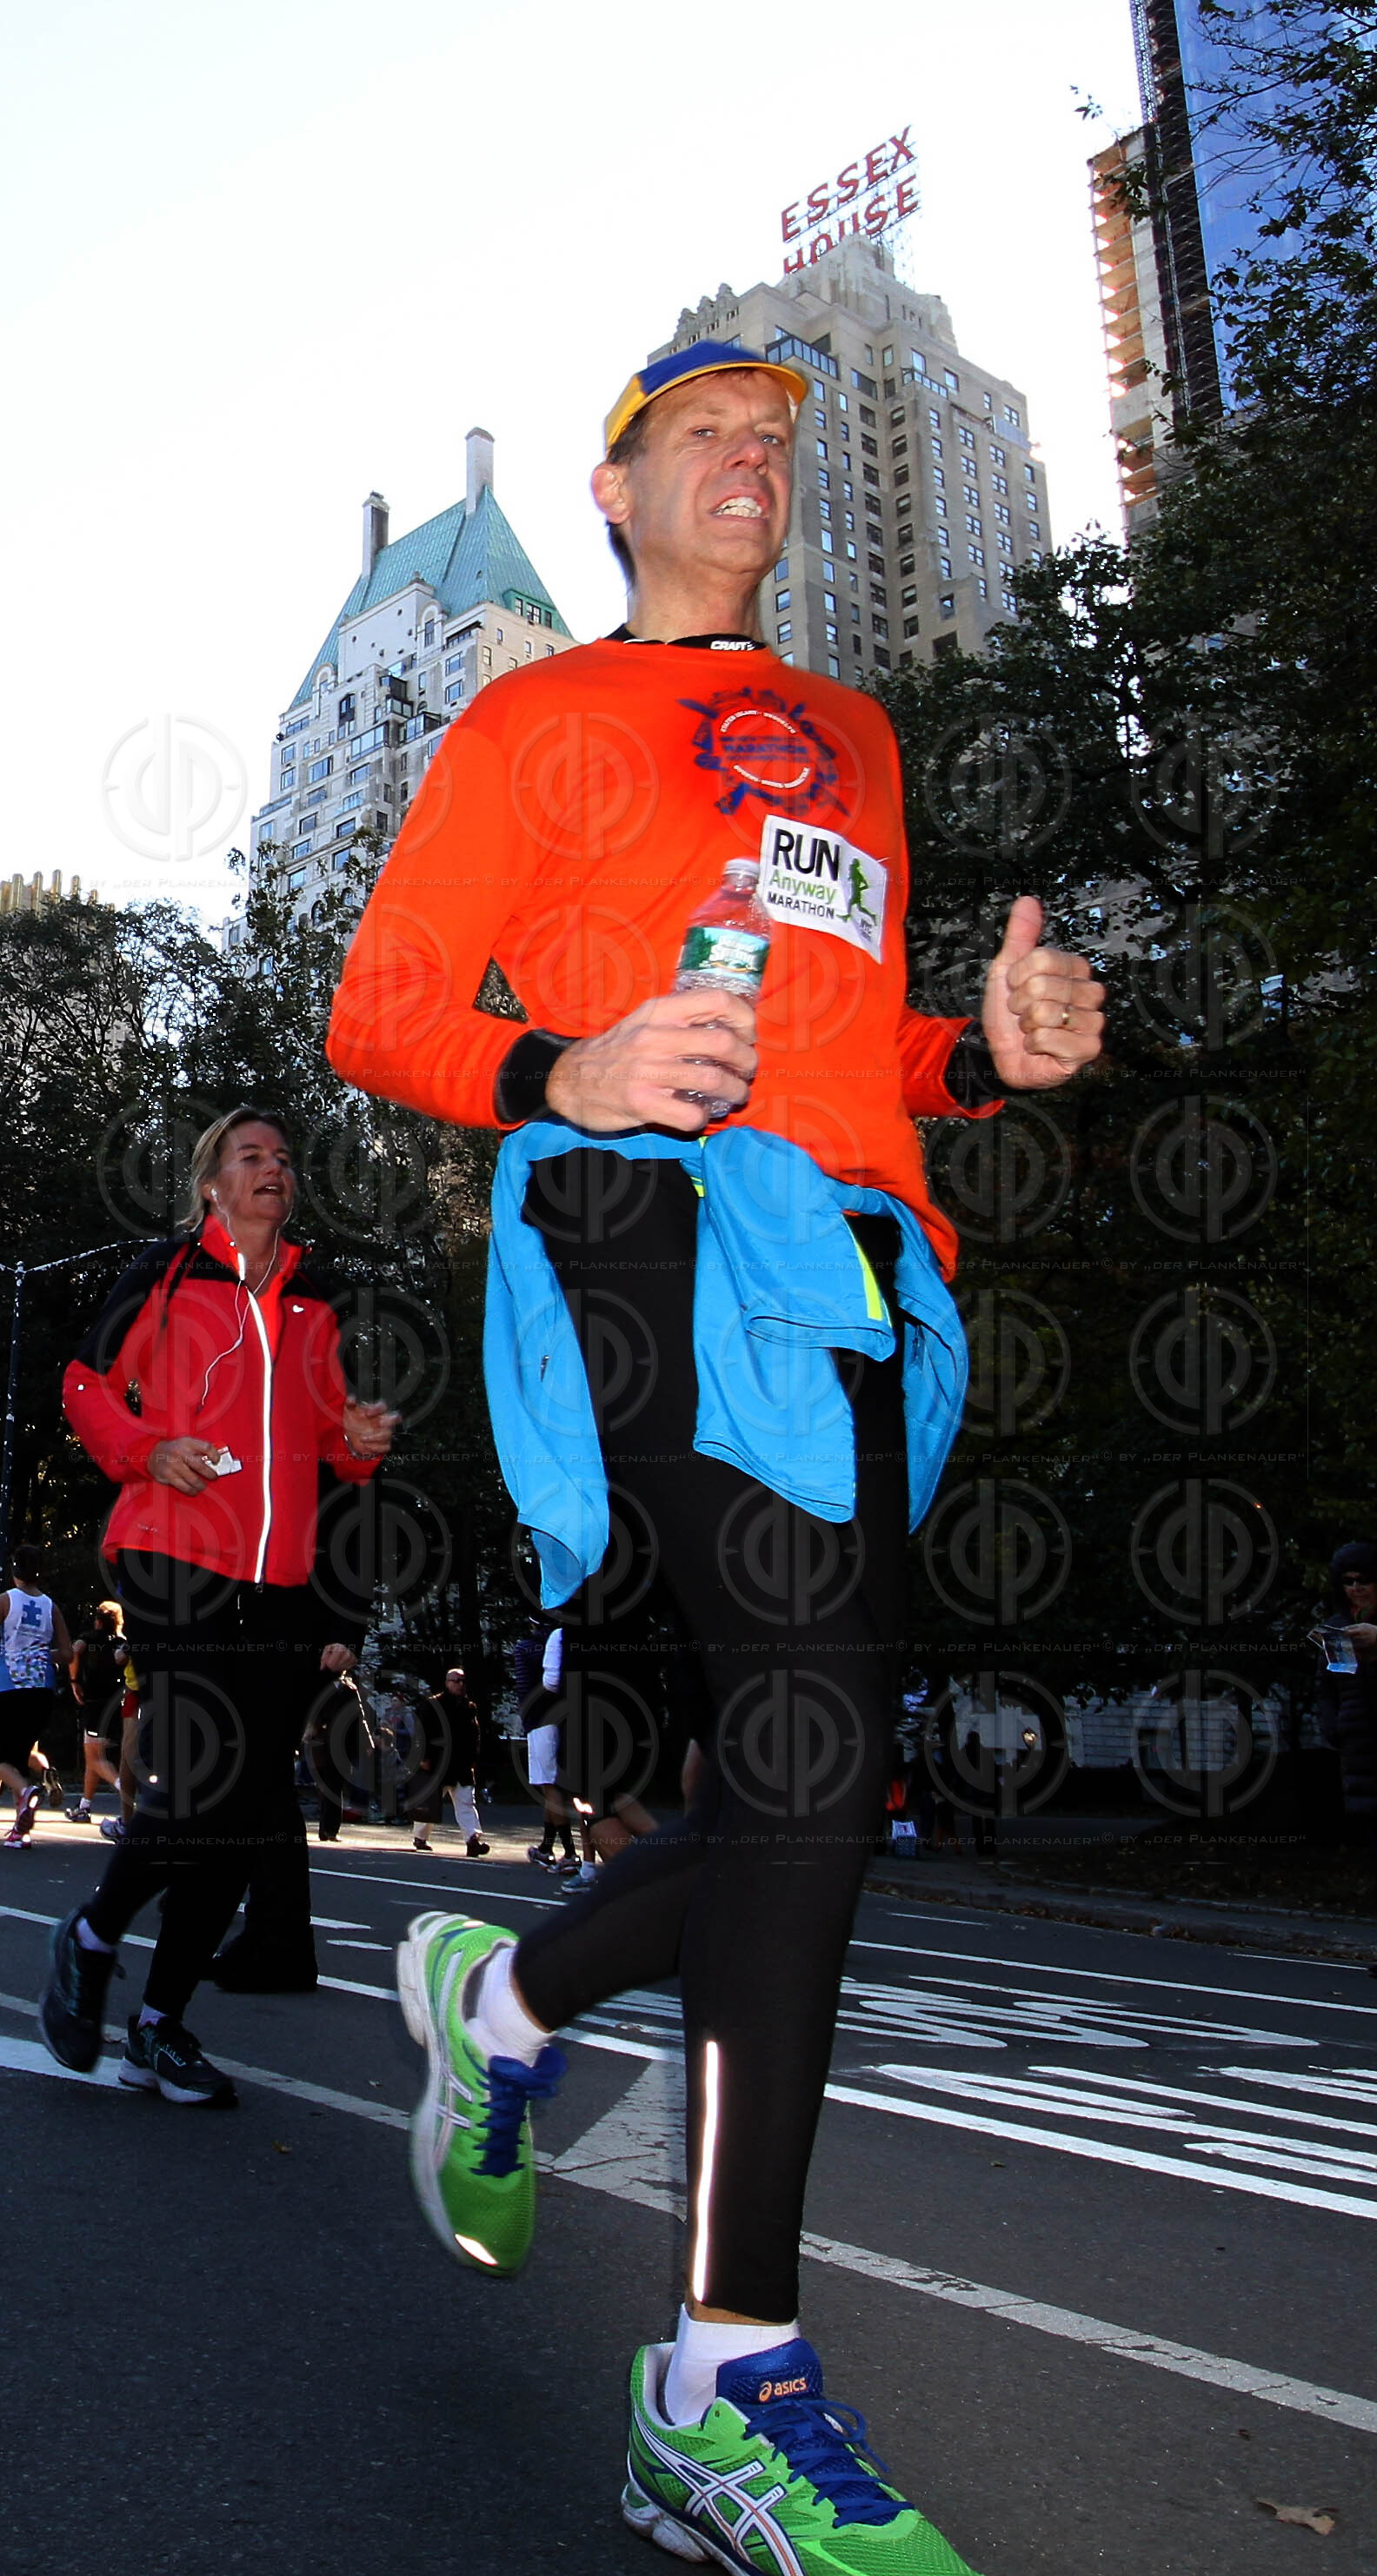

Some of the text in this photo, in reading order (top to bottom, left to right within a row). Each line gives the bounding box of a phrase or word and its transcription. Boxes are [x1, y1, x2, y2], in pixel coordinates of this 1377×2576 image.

[782, 126, 915, 242] ESSEX
[710, 641, 751, 651] CRAFT
[772, 828, 841, 882] RUN
[768, 868, 837, 905] Anyway
[767, 892, 835, 920] MARATHON
[774, 2377, 808, 2396] asics
